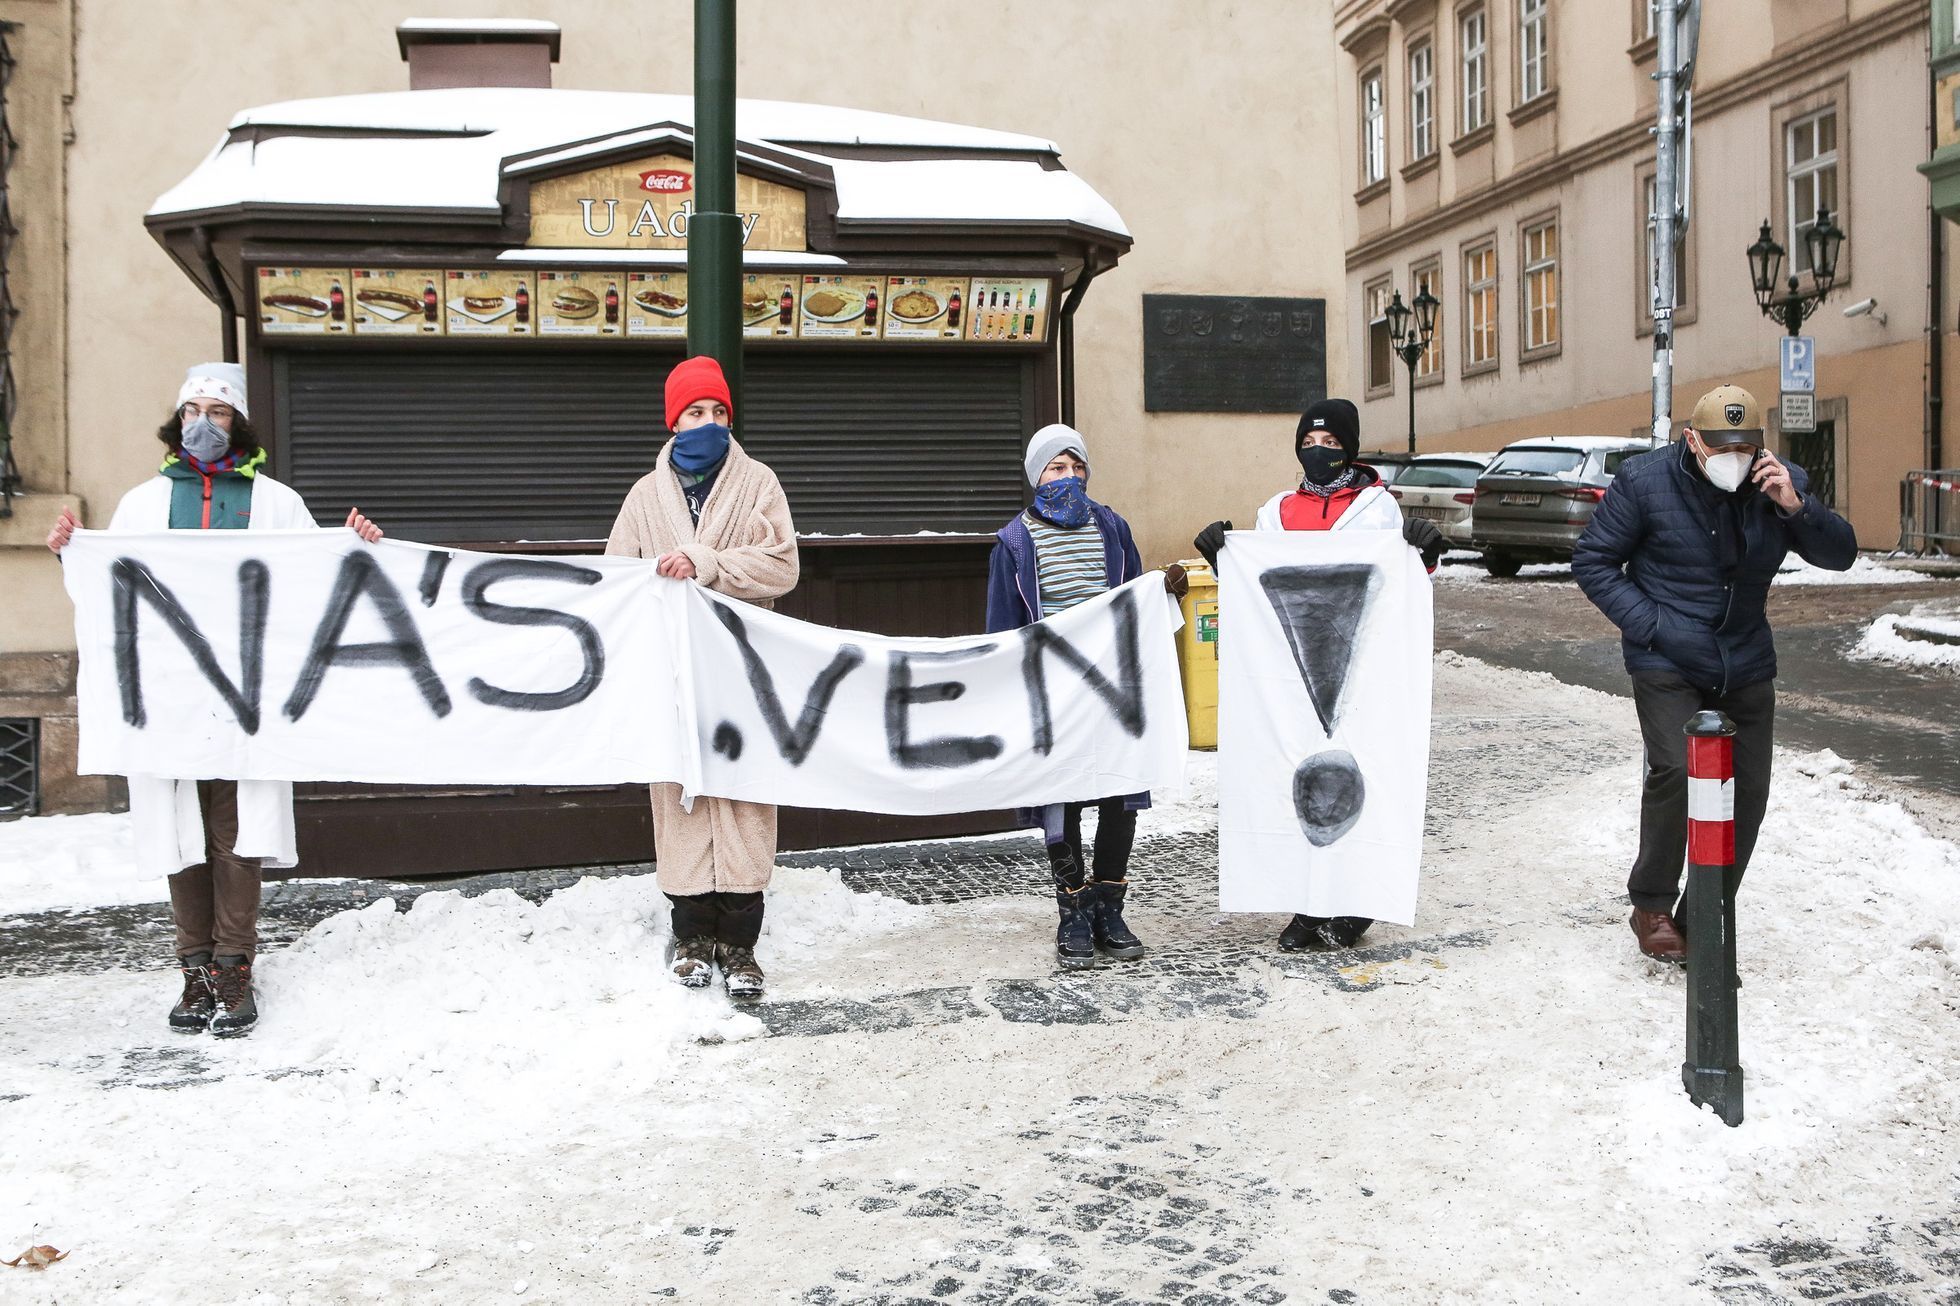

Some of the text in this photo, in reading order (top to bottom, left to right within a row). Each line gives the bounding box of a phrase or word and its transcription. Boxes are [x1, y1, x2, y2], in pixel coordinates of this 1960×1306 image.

[578, 199, 760, 246] U Ady
[1789, 340, 1806, 370] P
